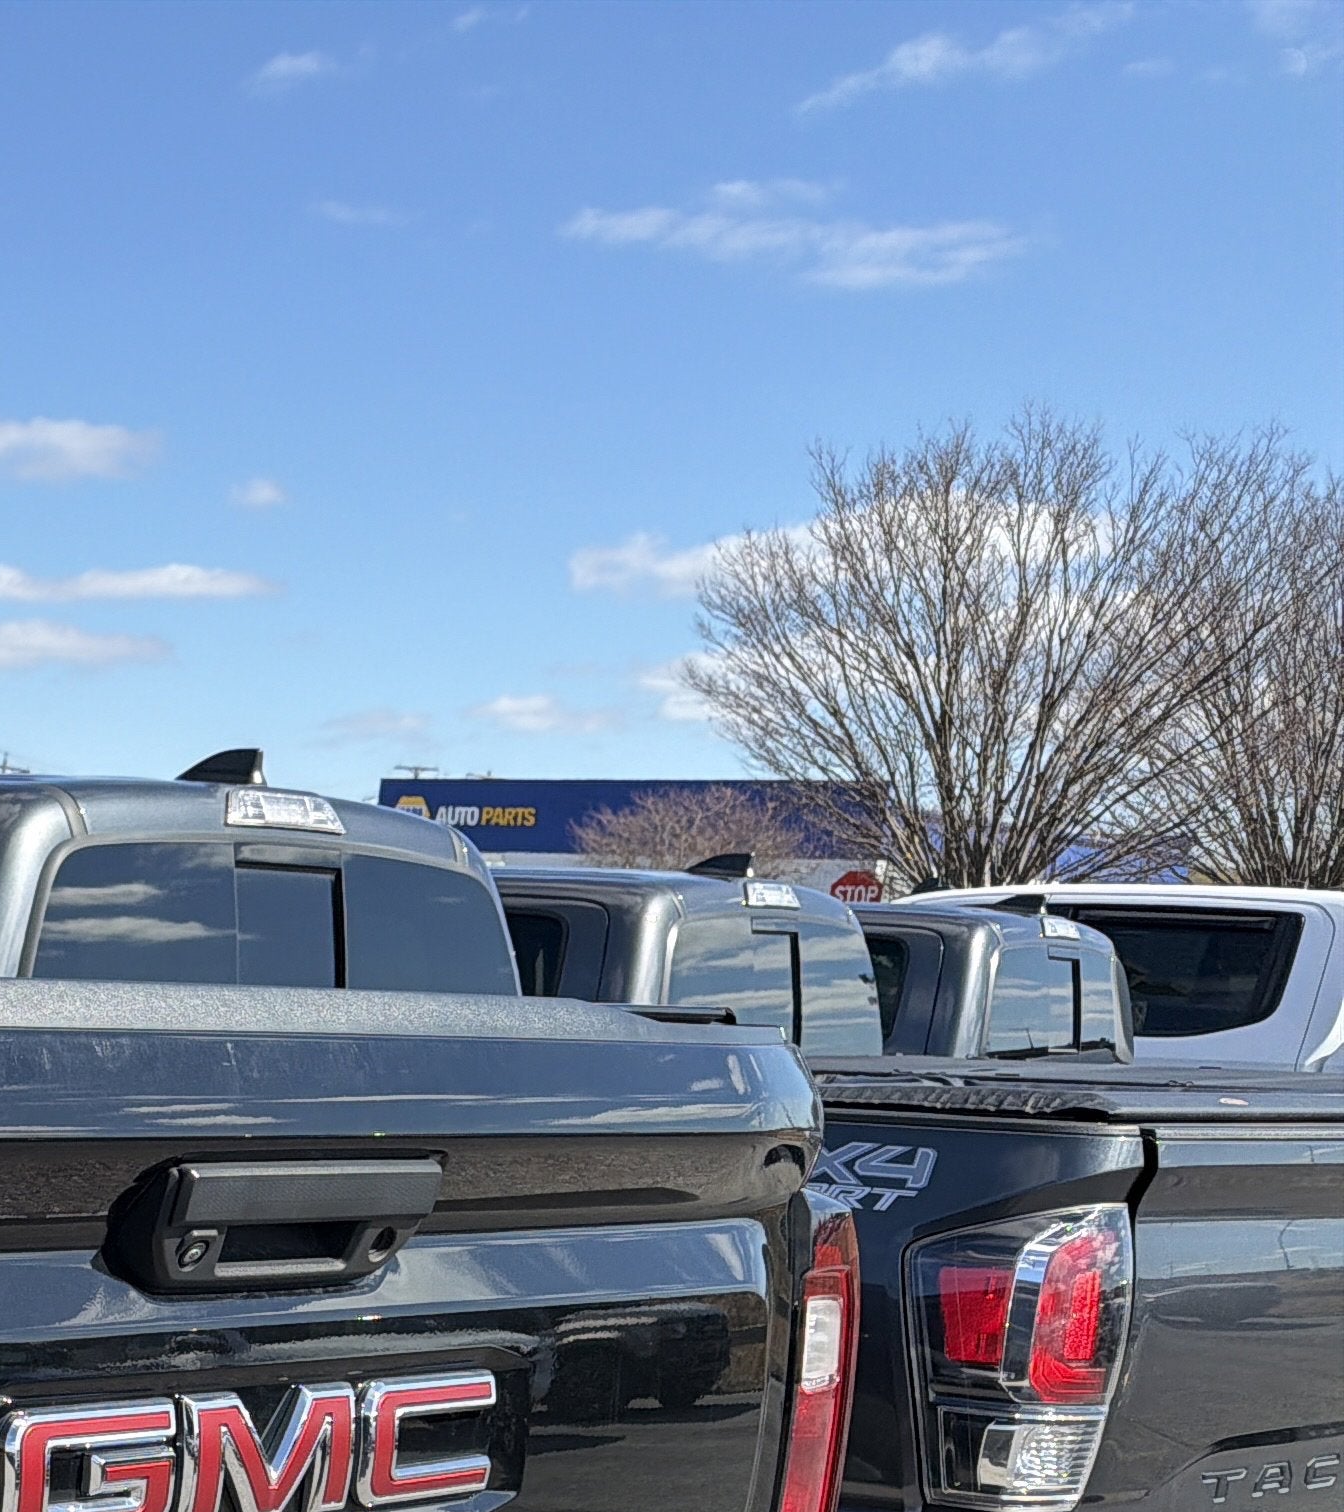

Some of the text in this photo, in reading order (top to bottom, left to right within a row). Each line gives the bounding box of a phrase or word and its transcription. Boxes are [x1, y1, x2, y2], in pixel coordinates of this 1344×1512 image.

[434, 805, 480, 827] AUTO
[480, 806, 537, 827] PARTS
[834, 884, 879, 904] STOP
[1201, 1452, 1341, 1504] TAC
